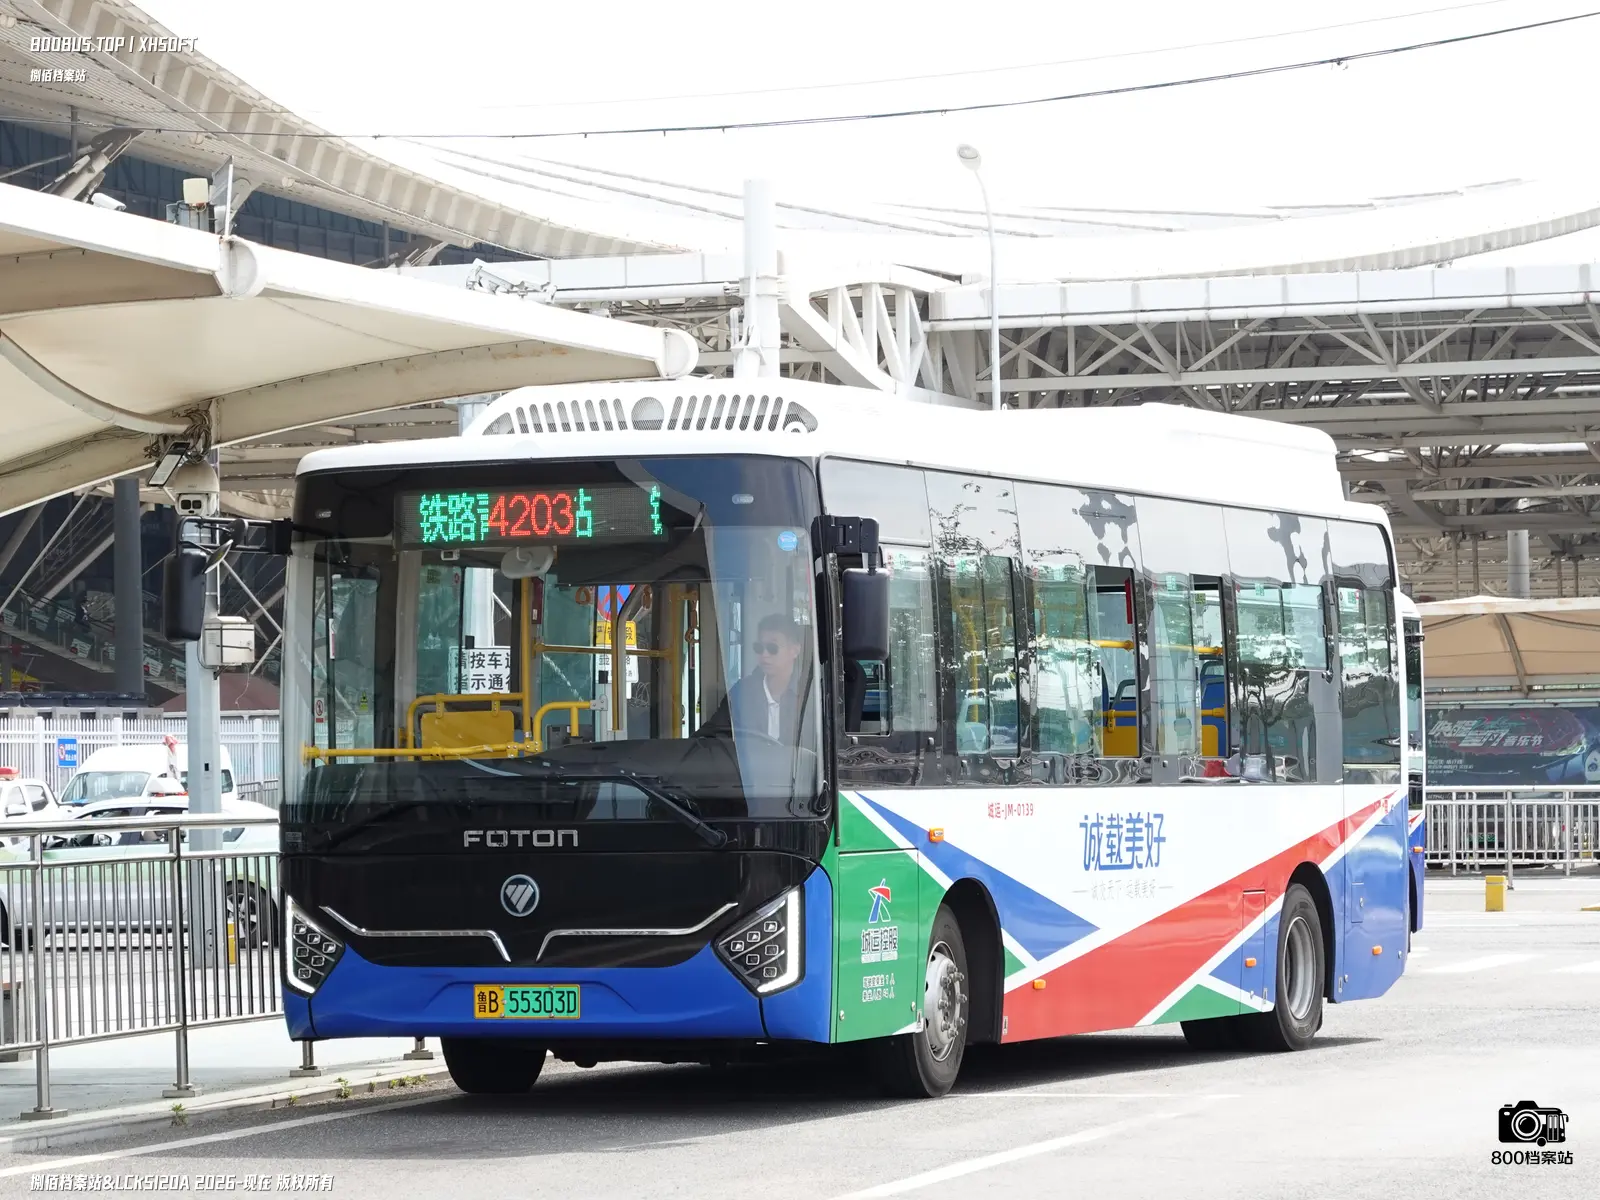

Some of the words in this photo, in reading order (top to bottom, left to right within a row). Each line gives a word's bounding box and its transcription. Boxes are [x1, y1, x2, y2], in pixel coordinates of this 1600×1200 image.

[488, 493, 575, 537] 4203
[463, 829, 579, 848] FOTON
[1079, 811, 1167, 872] 诚载美好
[861, 927, 898, 953] 城运控股
[477, 990, 499, 1014] 鲁B
[508, 990, 577, 1014] 55303D
